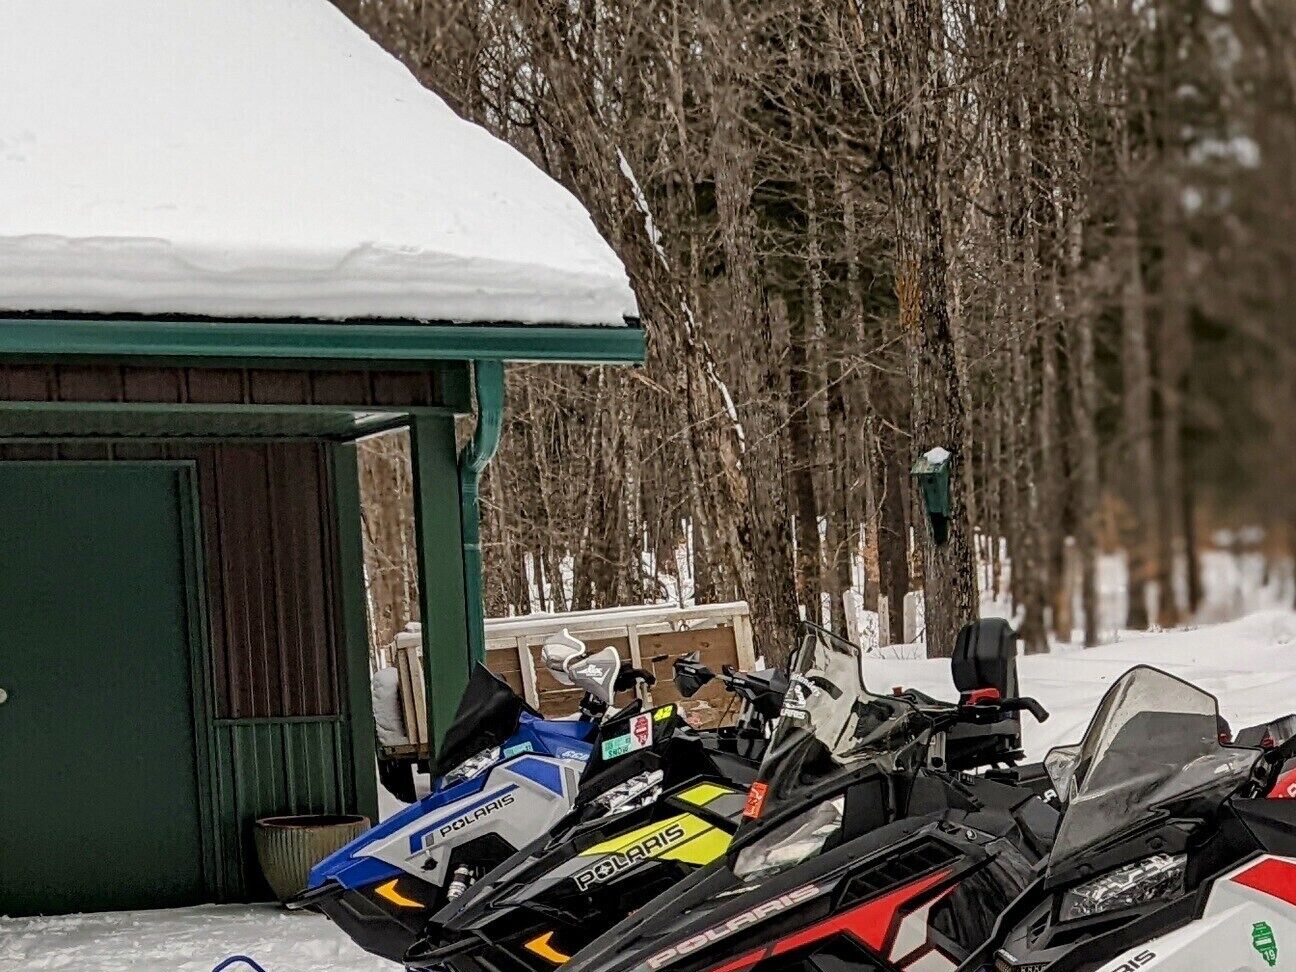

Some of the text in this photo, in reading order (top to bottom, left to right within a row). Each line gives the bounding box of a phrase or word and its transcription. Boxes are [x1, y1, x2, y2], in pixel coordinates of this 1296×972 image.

[440, 794, 516, 838] POLARIS
[573, 823, 686, 892] POLARIS
[648, 884, 820, 969] POLARIS
